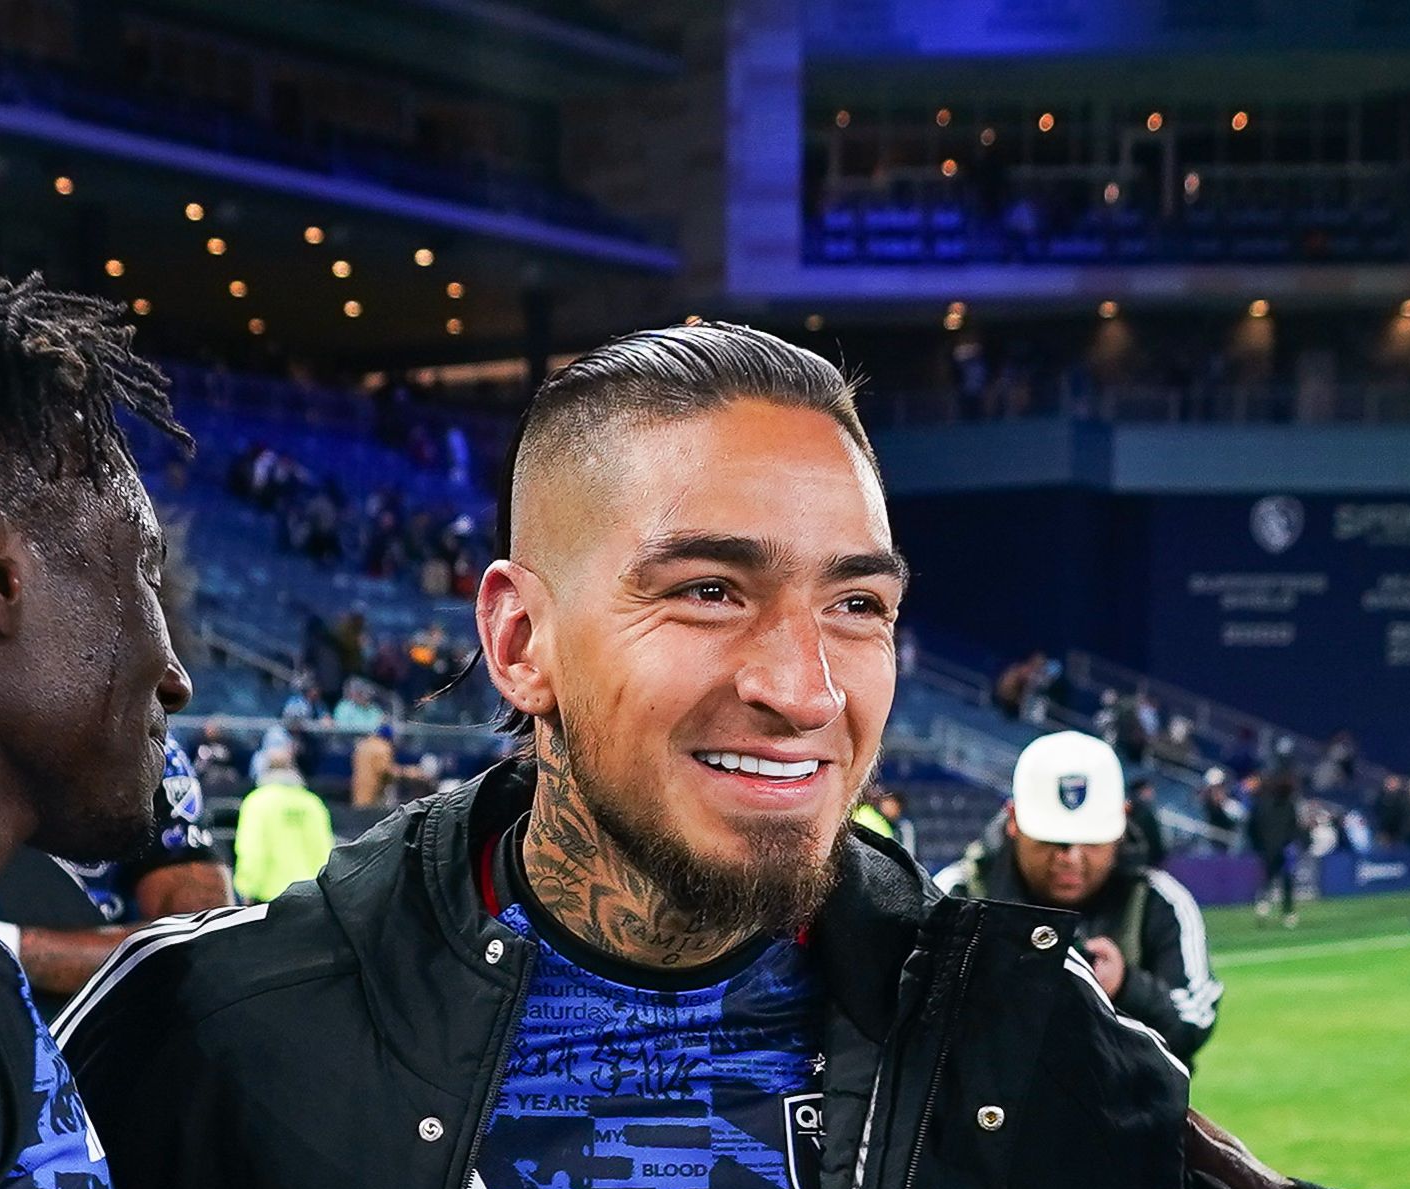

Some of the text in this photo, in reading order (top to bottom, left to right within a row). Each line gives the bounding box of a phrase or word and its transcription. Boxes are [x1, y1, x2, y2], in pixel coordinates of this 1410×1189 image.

[516, 1094, 591, 1112] YEARS
[594, 1128, 623, 1144] MY
[642, 1163, 708, 1178] BLOOD
